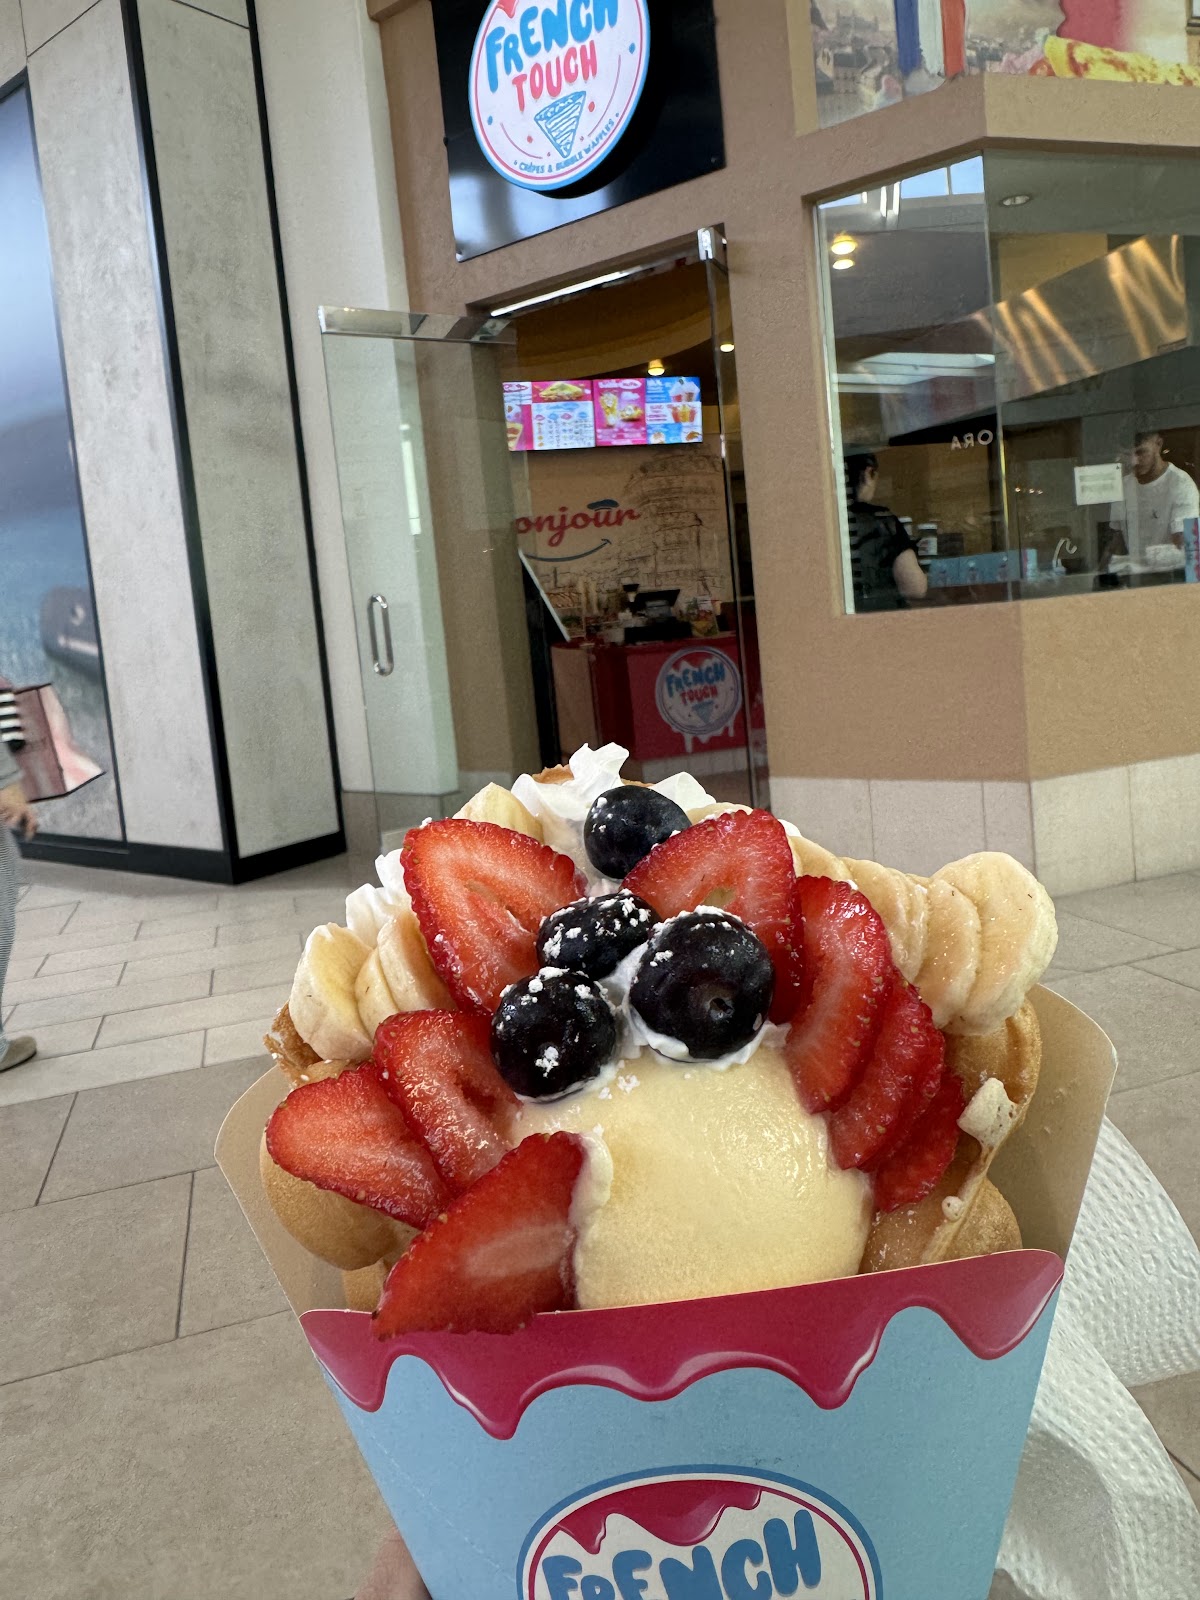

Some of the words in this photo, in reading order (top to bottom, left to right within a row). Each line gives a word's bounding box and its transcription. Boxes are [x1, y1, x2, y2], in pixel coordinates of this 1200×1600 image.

[485, 0, 618, 93] FRENCH
[511, 40, 598, 112] TOUCH
[514, 506, 641, 547] onjour
[665, 661, 726, 698] FRENCH
[680, 684, 718, 706] TOUCH
[542, 1508, 822, 1600] FRENCH
